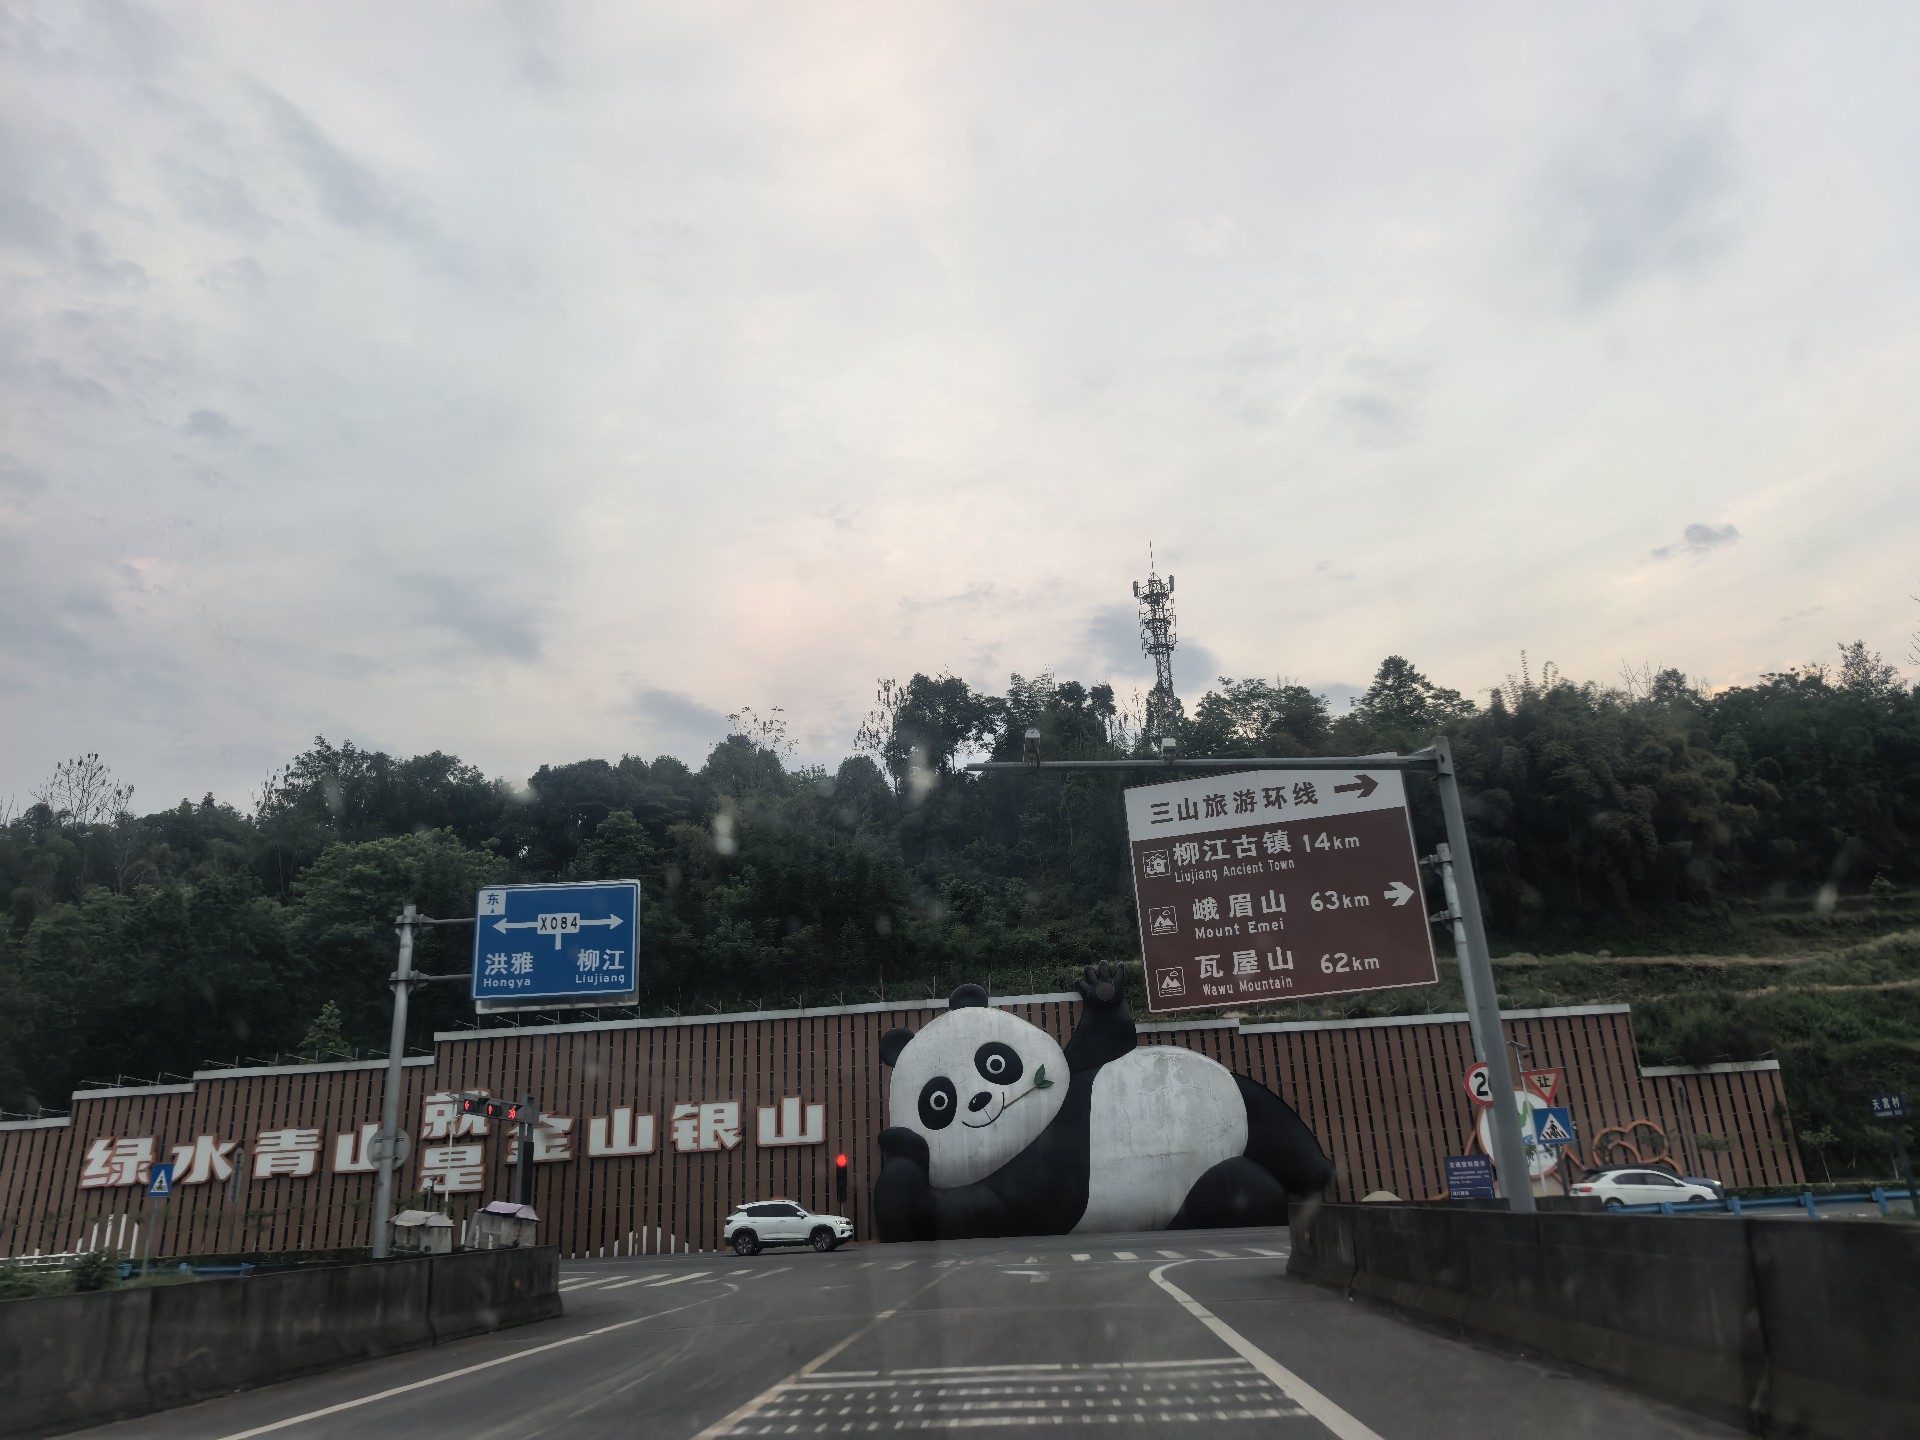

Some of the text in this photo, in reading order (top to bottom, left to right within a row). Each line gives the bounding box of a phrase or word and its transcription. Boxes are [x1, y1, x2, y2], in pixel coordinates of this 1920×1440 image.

[1150, 781, 1319, 825] 三山旅游环线
[1172, 829, 1360, 867] 柳江古镇 14km
[1174, 859, 1295, 885] Liujiang Ancient Town
[487, 892, 500, 906] 东
[1192, 889, 1370, 922] 峨眉山 63km
[540, 916, 579, 931] X084
[1195, 919, 1285, 940] Mount Emei
[484, 951, 534, 976] 洪雅
[576, 949, 625, 972] 柳江
[1194, 946, 1380, 980] 瓦屋山 62km
[483, 977, 531, 989] Hongya
[575, 973, 625, 985] Liujiang
[1202, 975, 1293, 997] Wawu Mountain
[1536, 1075, 1552, 1088] 让
